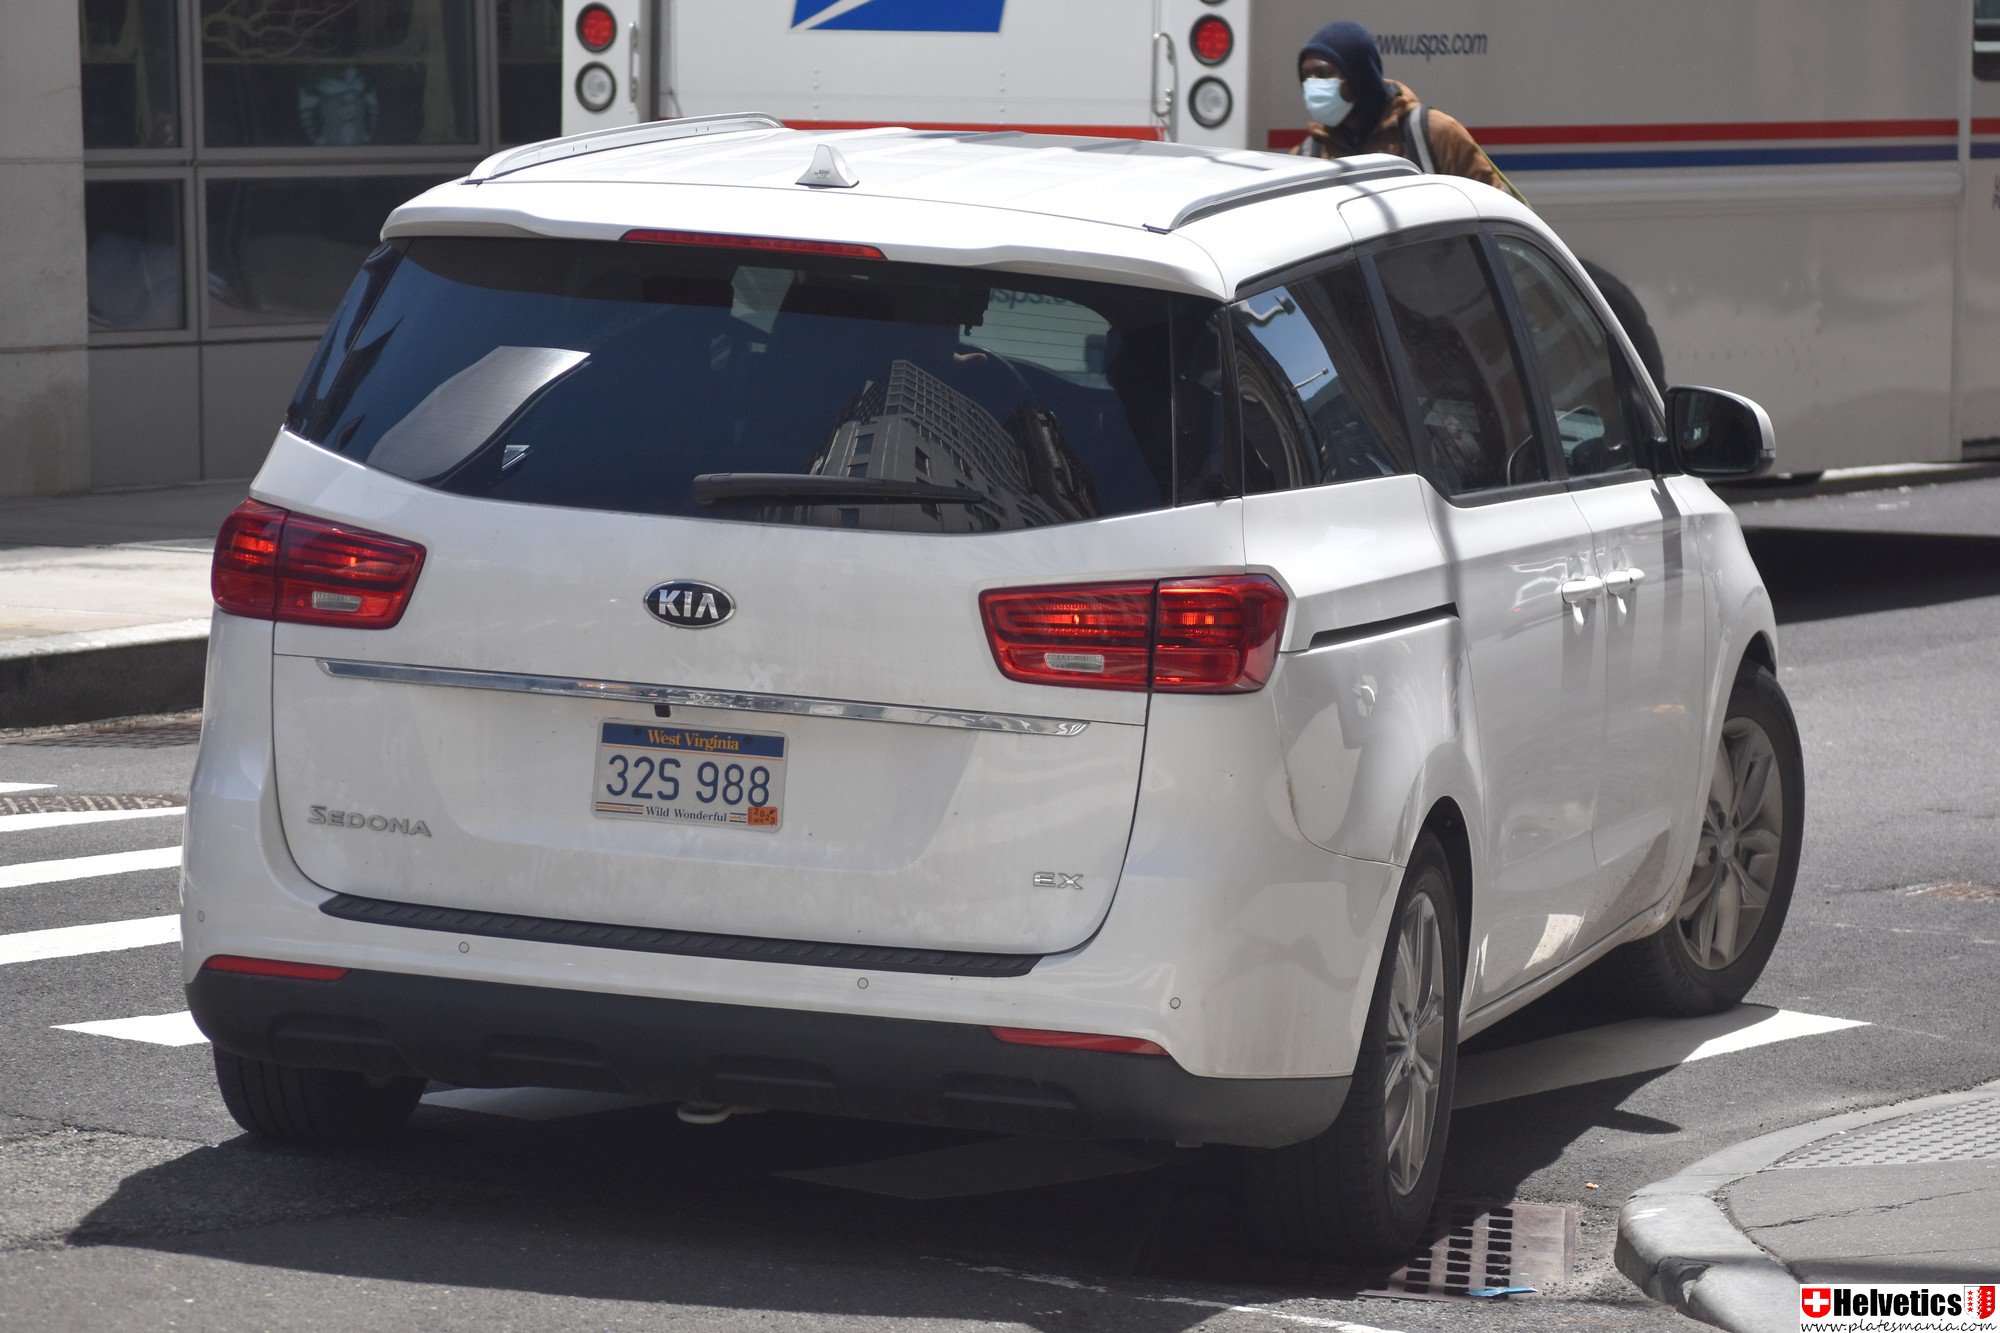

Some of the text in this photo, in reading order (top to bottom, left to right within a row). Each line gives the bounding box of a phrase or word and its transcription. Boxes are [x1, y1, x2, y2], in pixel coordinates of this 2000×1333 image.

[658, 589, 719, 619] KIA
[648, 729, 740, 751] West Virginia
[695, 761, 770, 807] 988
[307, 804, 433, 837] SEDONA
[646, 806, 727, 822] Wild Wonderful
[1033, 871, 1084, 890] EX
